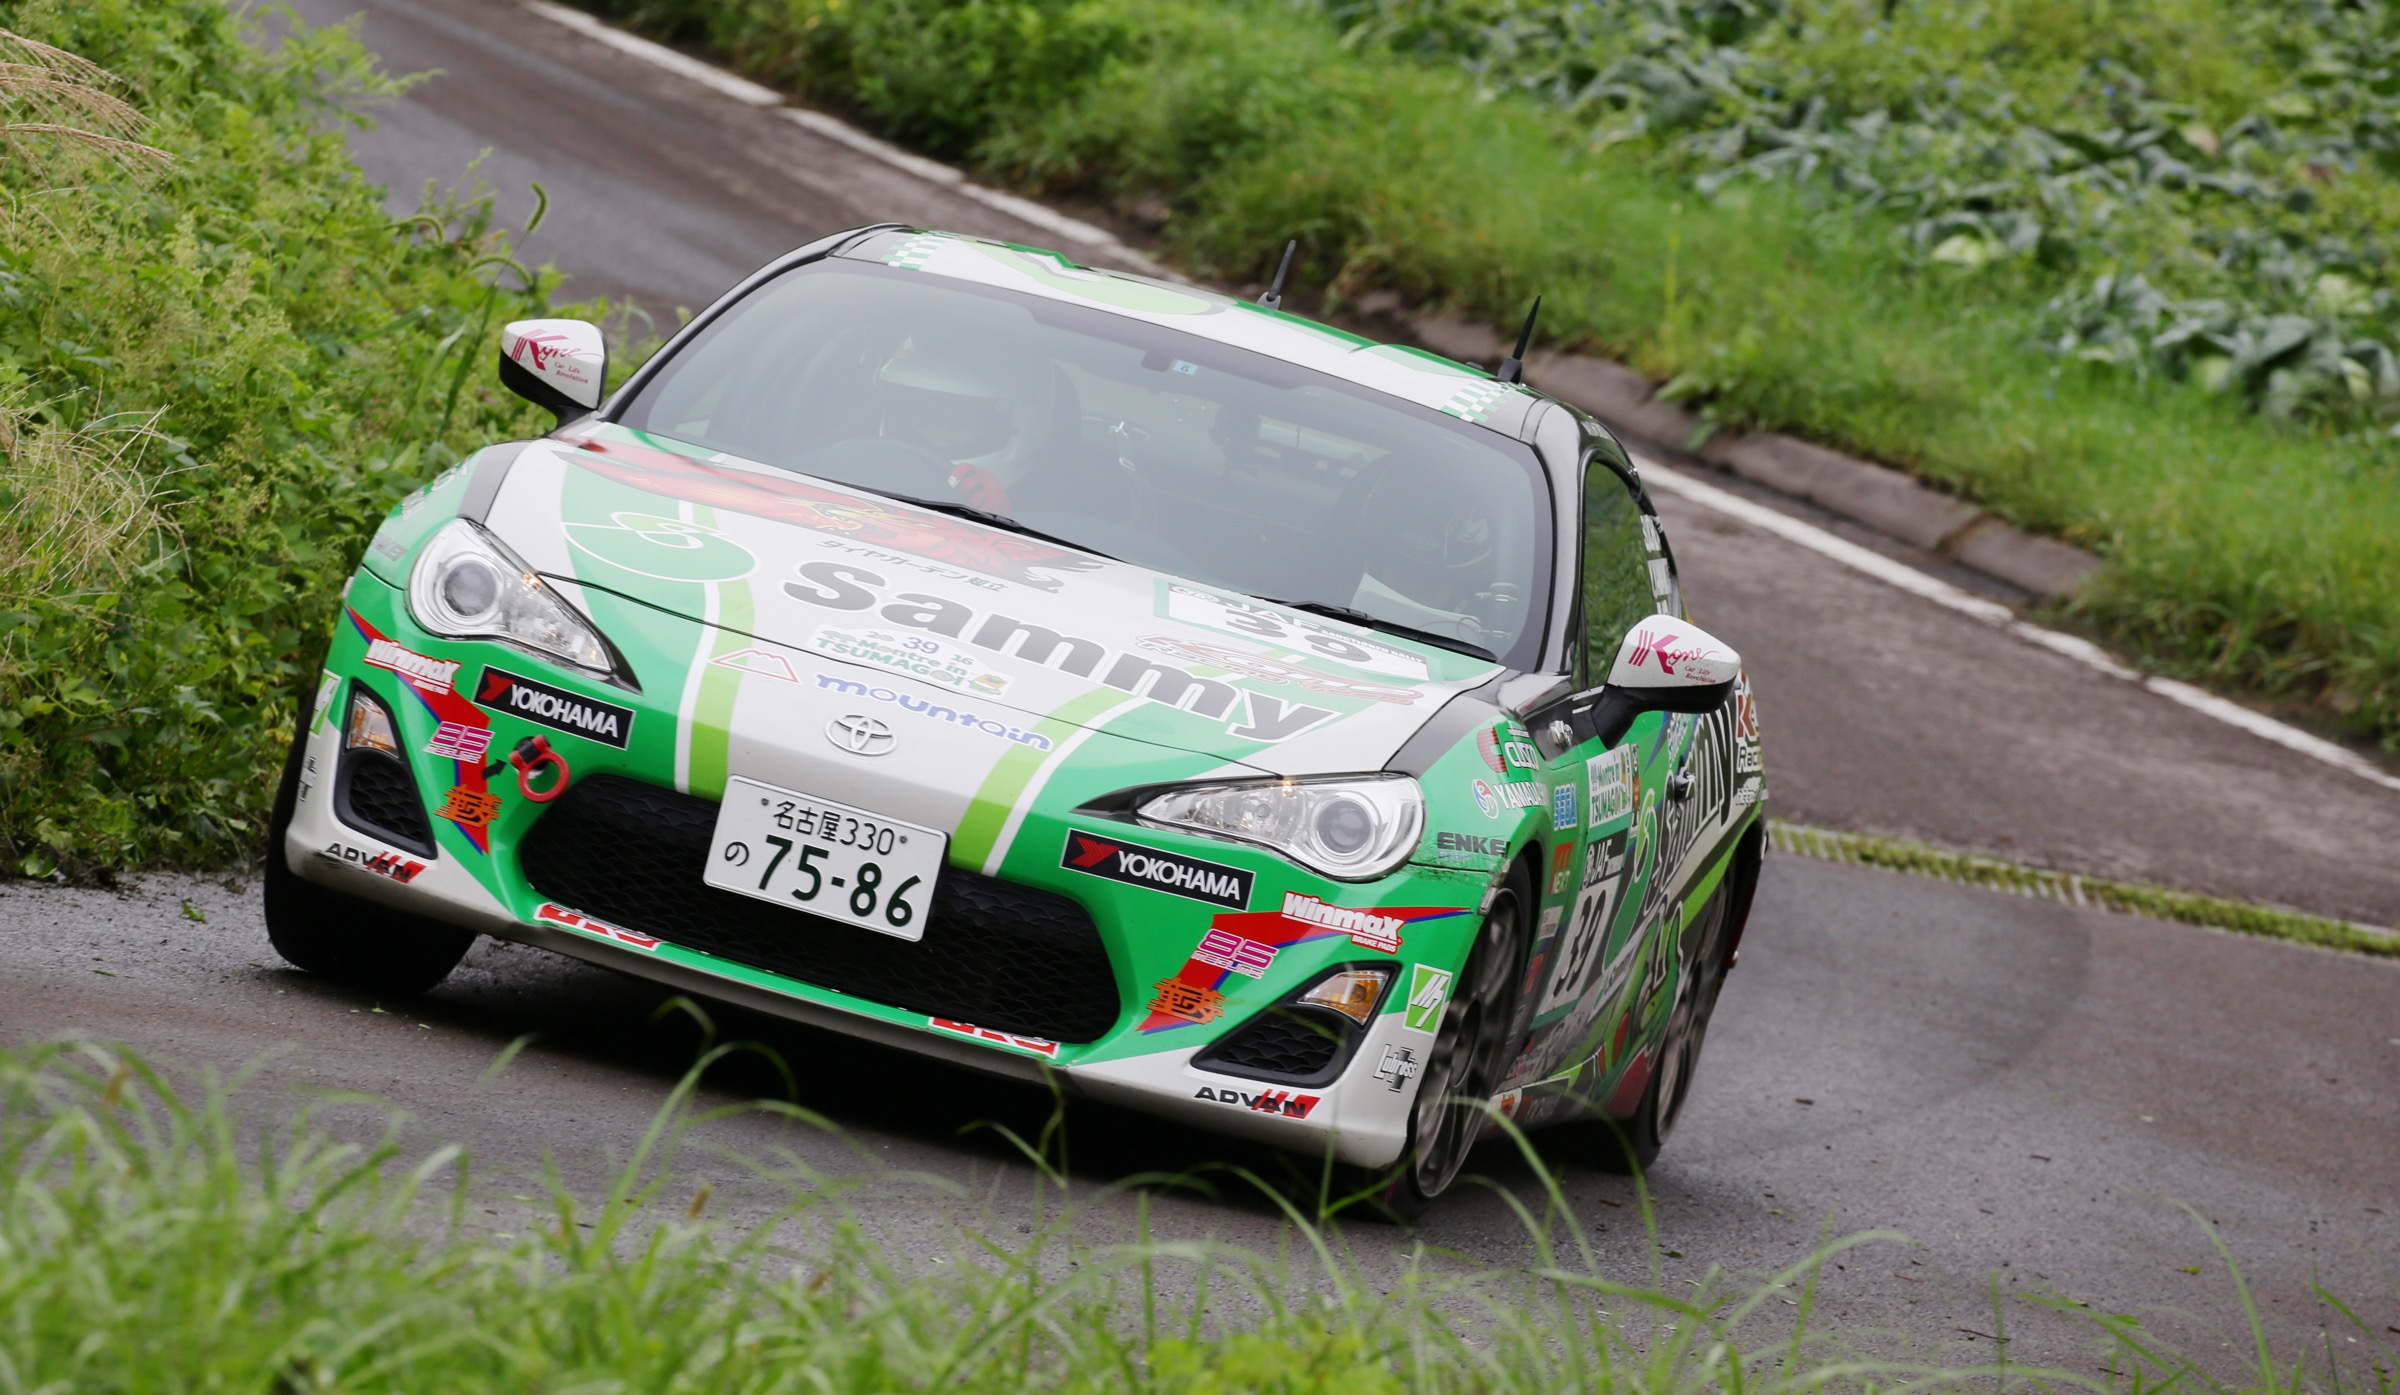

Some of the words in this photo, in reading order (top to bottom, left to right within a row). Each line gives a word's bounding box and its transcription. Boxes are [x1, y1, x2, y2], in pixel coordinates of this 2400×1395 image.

[783, 561, 1342, 742] Sammy
[902, 636, 940, 655] 39
[950, 653, 975, 666] 16
[1225, 608, 1373, 662] 39
[946, 662, 968, 676] in
[510, 684, 618, 738] YOKOHAMA
[815, 673, 1052, 751] mountain
[724, 841, 750, 867] の
[758, 833, 922, 928] 75-86
[1117, 850, 1241, 901] YOKOHAMA
[1197, 928, 1280, 969] 85
[1193, 1085, 1308, 1117] ADVAN
